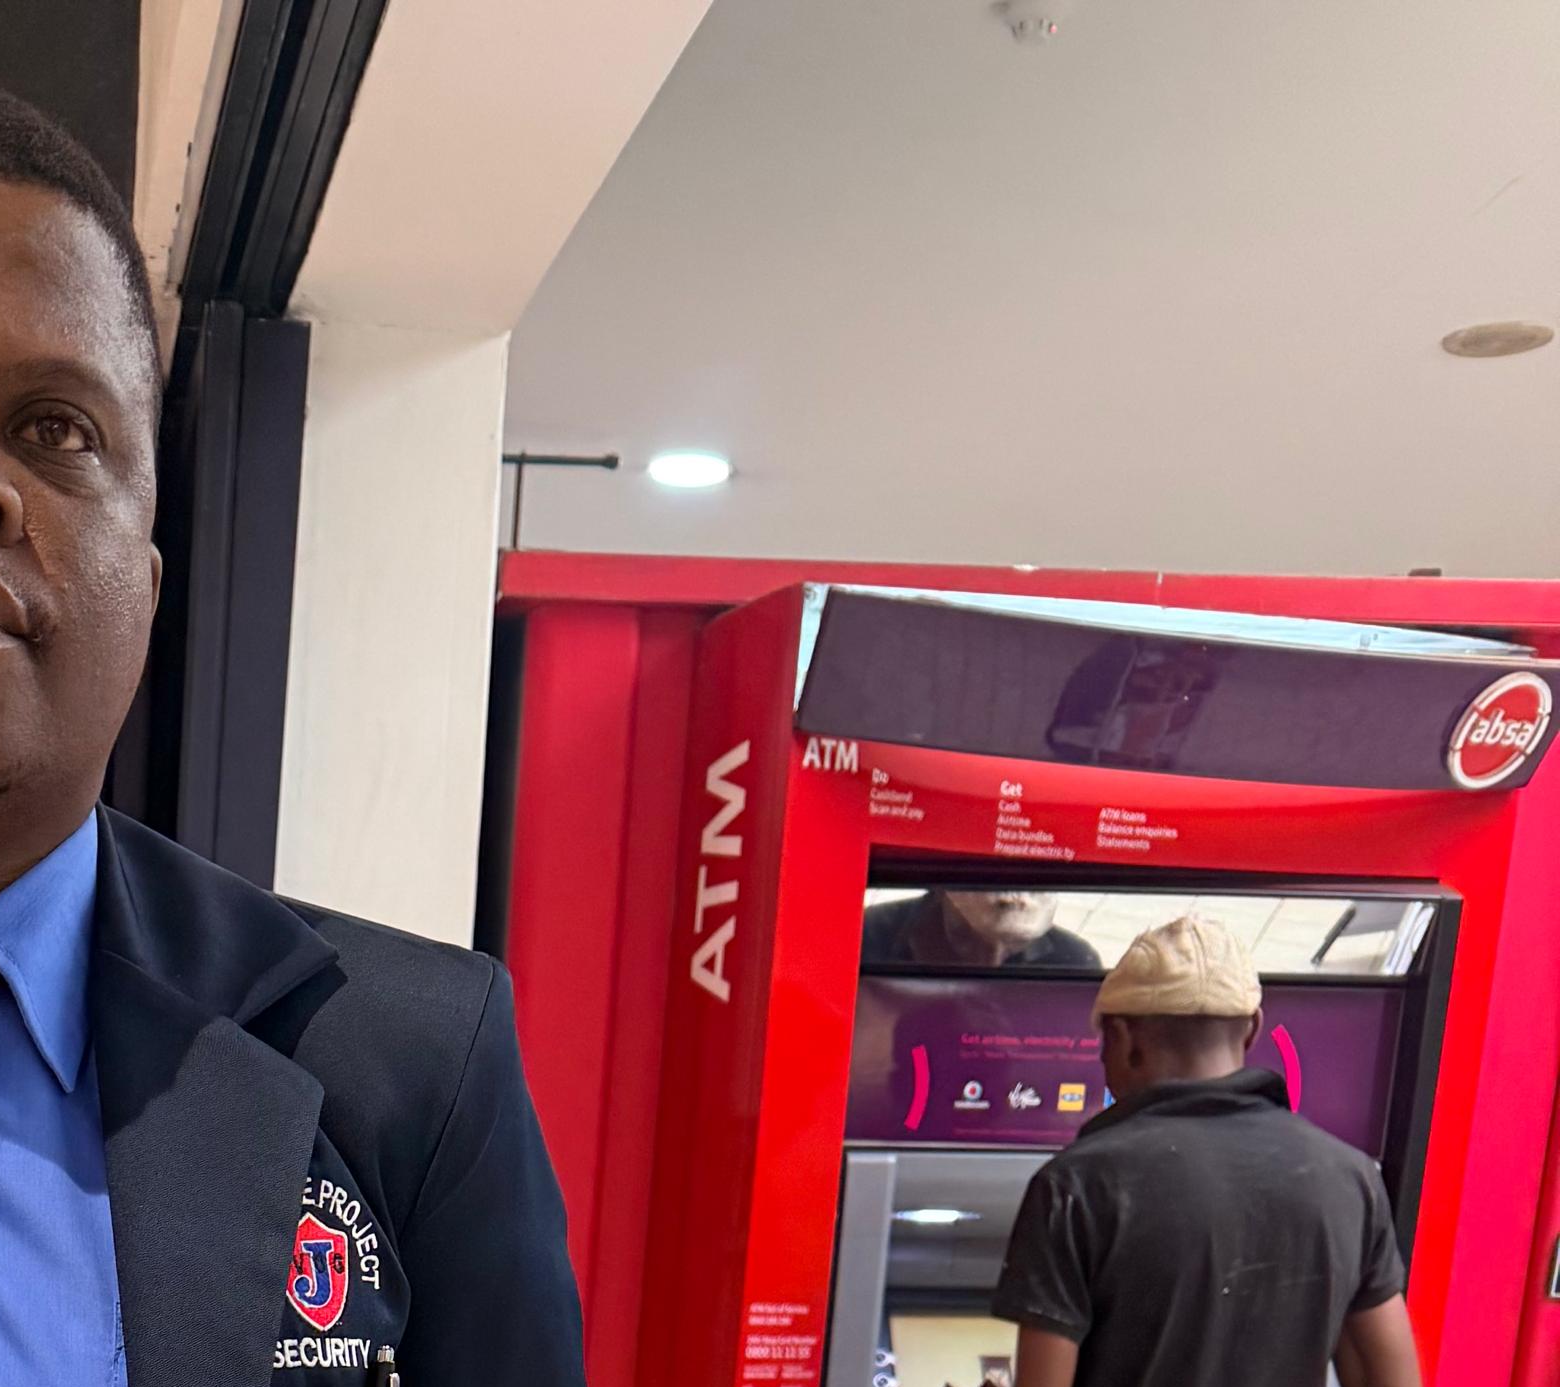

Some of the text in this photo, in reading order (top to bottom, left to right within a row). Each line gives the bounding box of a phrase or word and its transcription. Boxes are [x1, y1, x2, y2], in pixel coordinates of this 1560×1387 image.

[1470, 708, 1535, 748] absa
[802, 736, 859, 773] ATM
[1000, 780, 1023, 798] Get
[690, 739, 751, 1003] ATM
[318, 1179, 380, 1290] PROJECT
[293, 1240, 334, 1309] J
[273, 1337, 370, 1369] SECURITY
